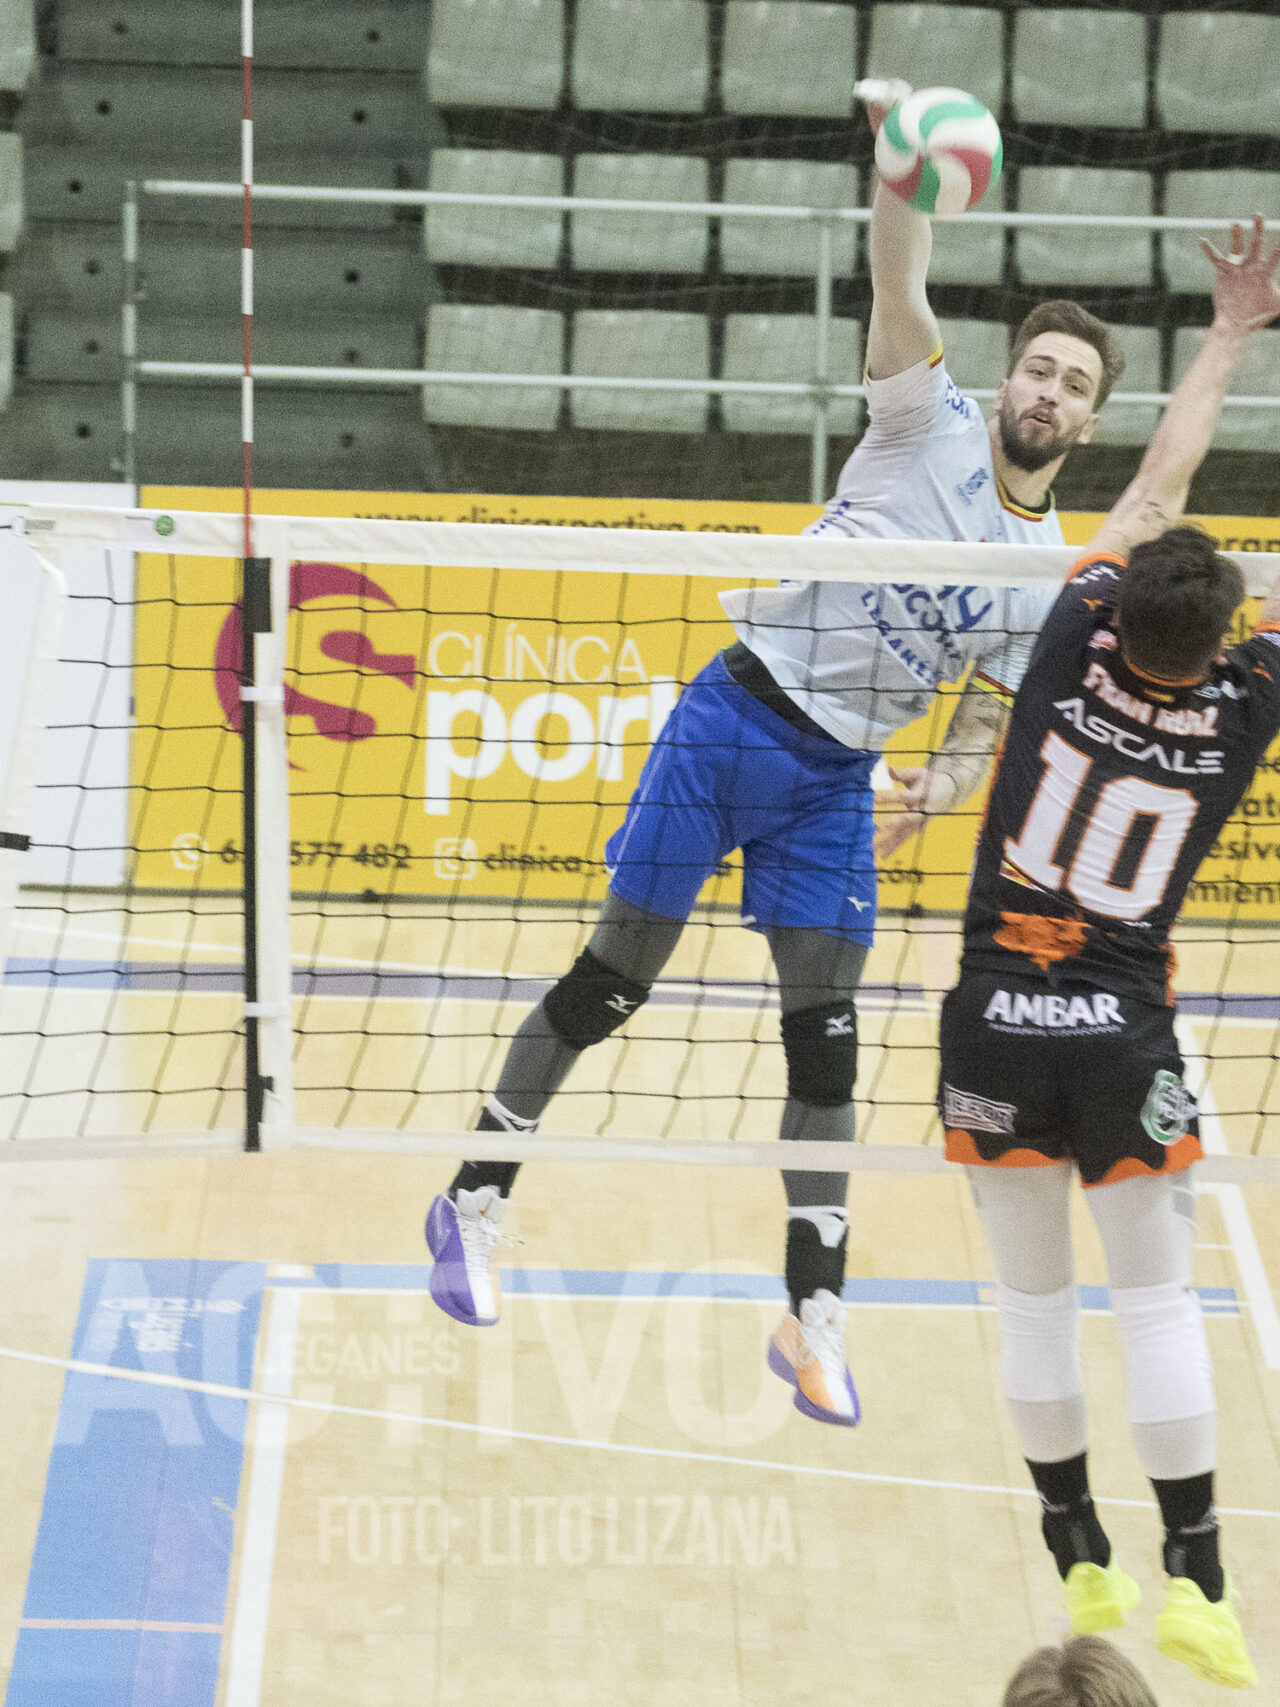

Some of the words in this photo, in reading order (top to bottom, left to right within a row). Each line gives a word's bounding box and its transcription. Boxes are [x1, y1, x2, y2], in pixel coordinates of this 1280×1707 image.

[428, 622, 649, 683] CLÍNICA
[1052, 697, 1226, 775] ASCALE
[1003, 729, 1201, 921] 10
[982, 988, 1127, 1027] AMBAR
